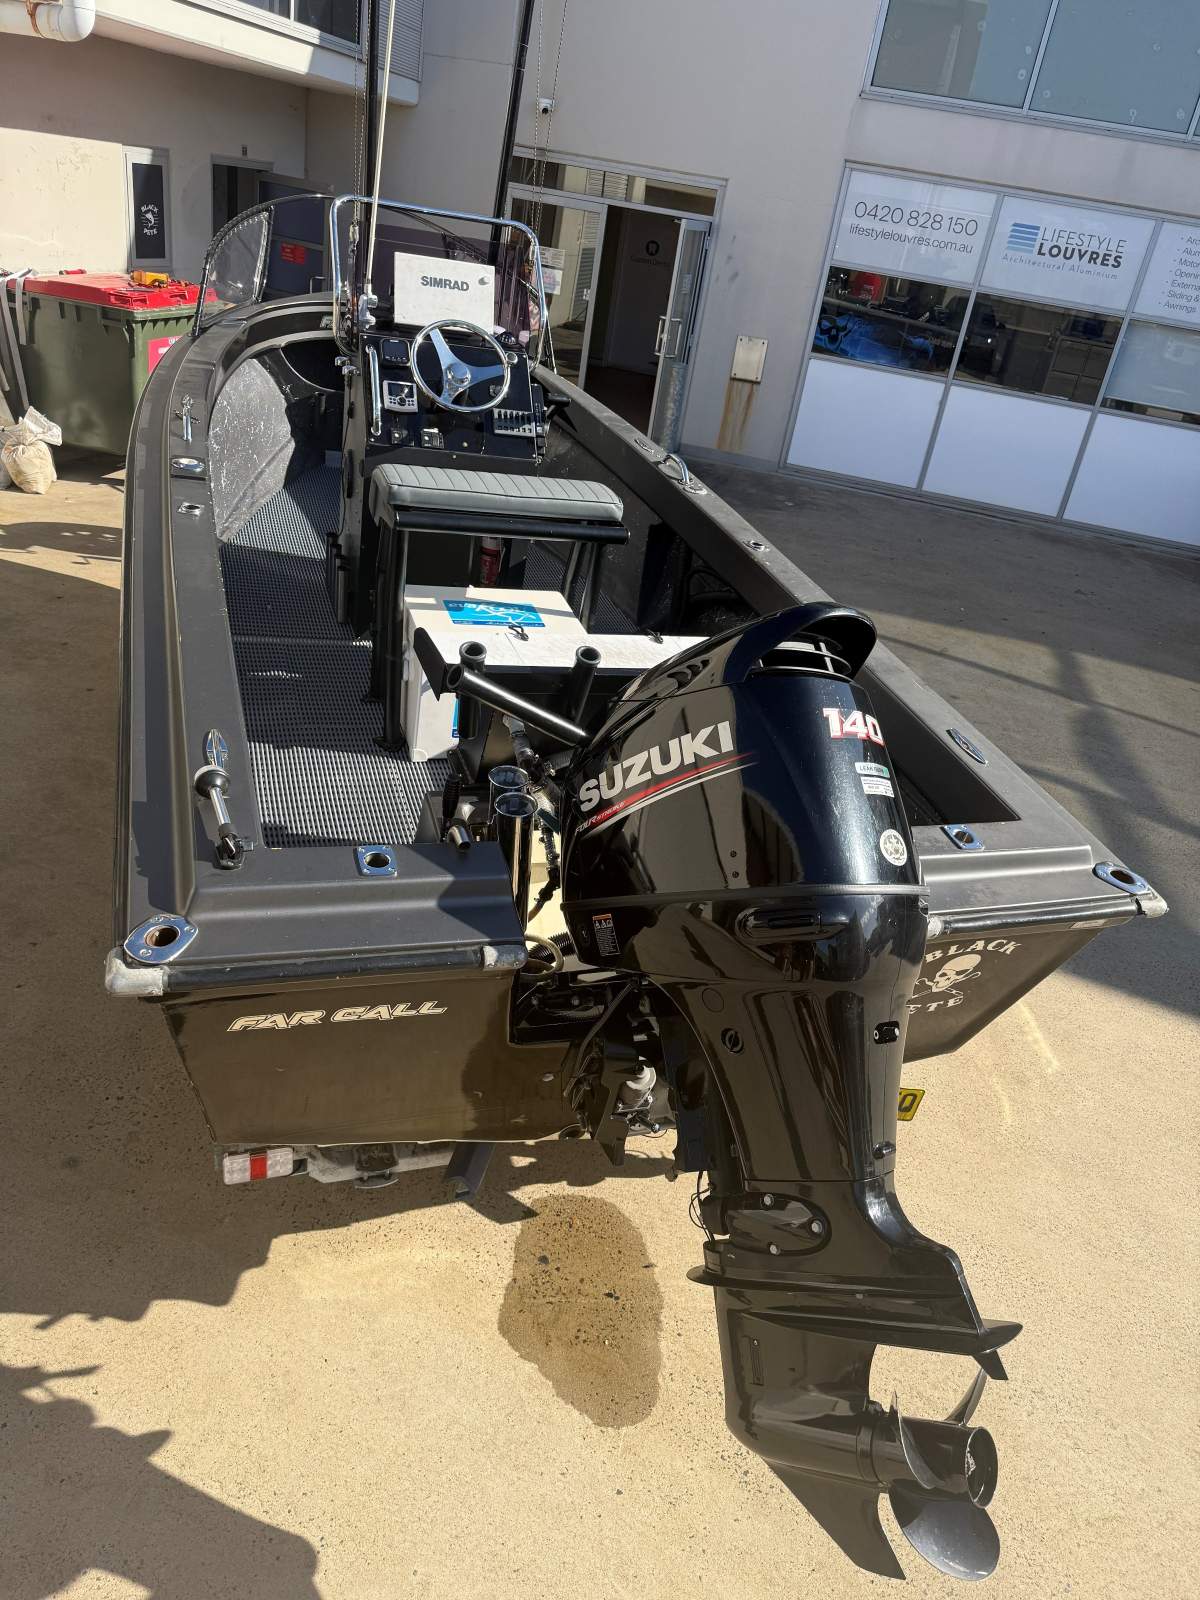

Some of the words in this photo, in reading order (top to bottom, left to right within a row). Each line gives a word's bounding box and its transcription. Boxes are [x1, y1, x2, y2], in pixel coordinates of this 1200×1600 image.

[854, 201, 904, 224] 0420
[907, 210, 944, 231] 828
[947, 216, 978, 236] 150
[849, 223, 974, 254] lifestylelouvres.com.au
[1041, 227, 1128, 254] LIFESTYLE
[1001, 253, 1065, 272] Architectural
[1068, 264, 1119, 280] Aluminium
[1037, 242, 1123, 269] LOUVRES
[420, 275, 470, 292] SIMRAD
[822, 707, 885, 747] 140
[579, 720, 734, 813] SUZUKI
[925, 939, 1022, 963] BLACK
[226, 1010, 326, 1032] FAR
[330, 1001, 448, 1023] CALL
[906, 996, 964, 1015] ETE
